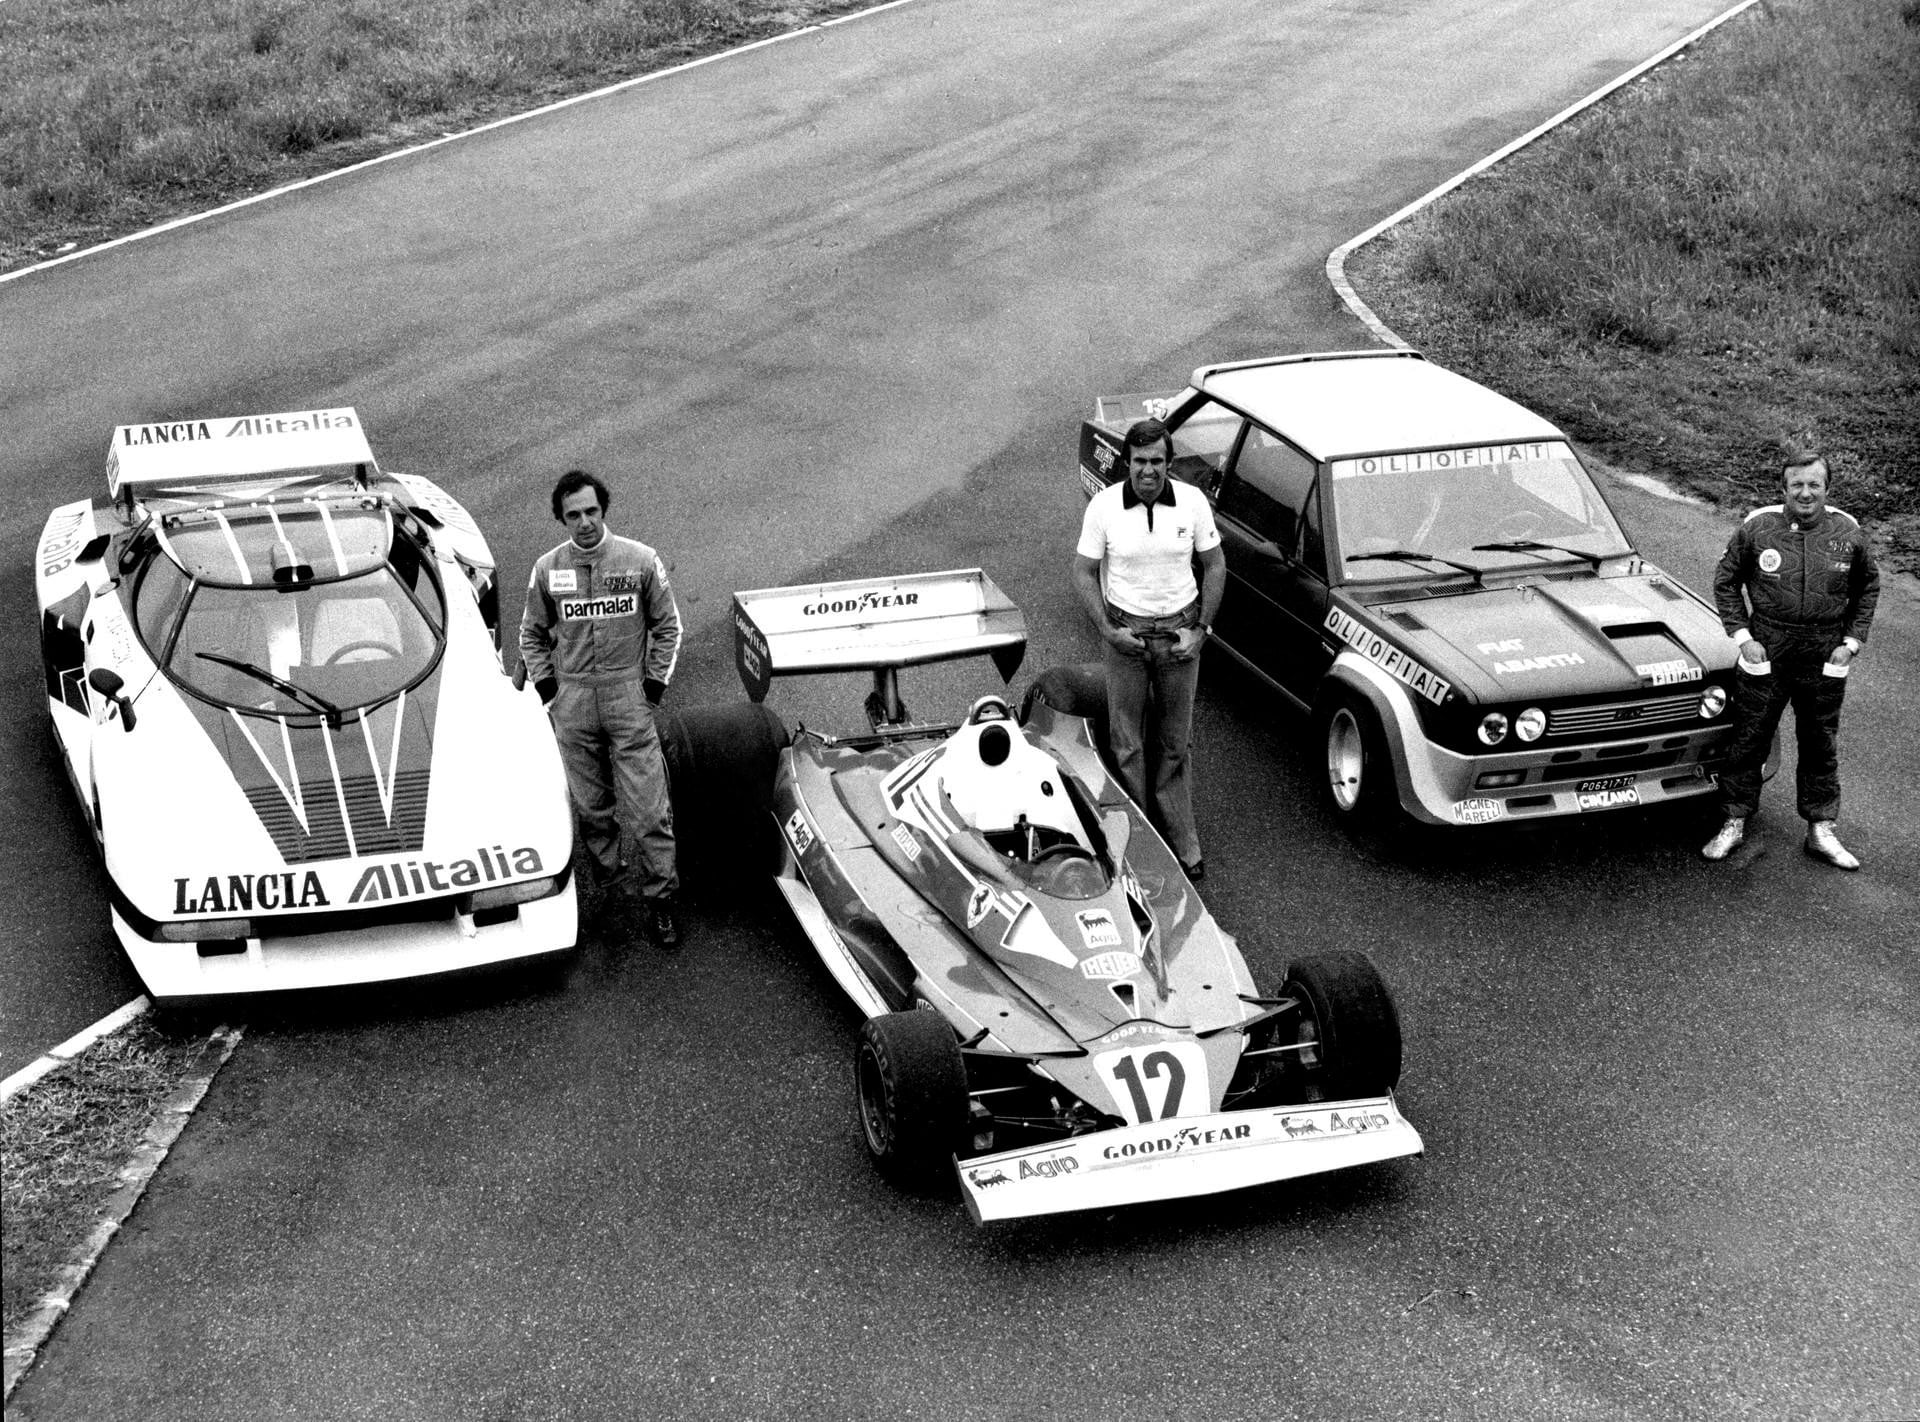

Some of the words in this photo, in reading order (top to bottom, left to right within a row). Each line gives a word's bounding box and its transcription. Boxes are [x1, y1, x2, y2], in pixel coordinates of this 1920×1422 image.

[123, 421, 211, 446] LANCIA
[225, 412, 354, 438] Alitalia
[563, 596, 634, 619] parmalat
[1477, 639, 1525, 655] FIAT
[1493, 652, 1586, 675] ABARTH
[1579, 789, 1638, 808] CINZANO
[173, 870, 331, 915] LANCIA
[347, 844, 545, 904] Alitalia
[1112, 1050, 1186, 1124] 12
[1330, 1109, 1389, 1133] Agip
[1018, 1152, 1079, 1179] Agip
